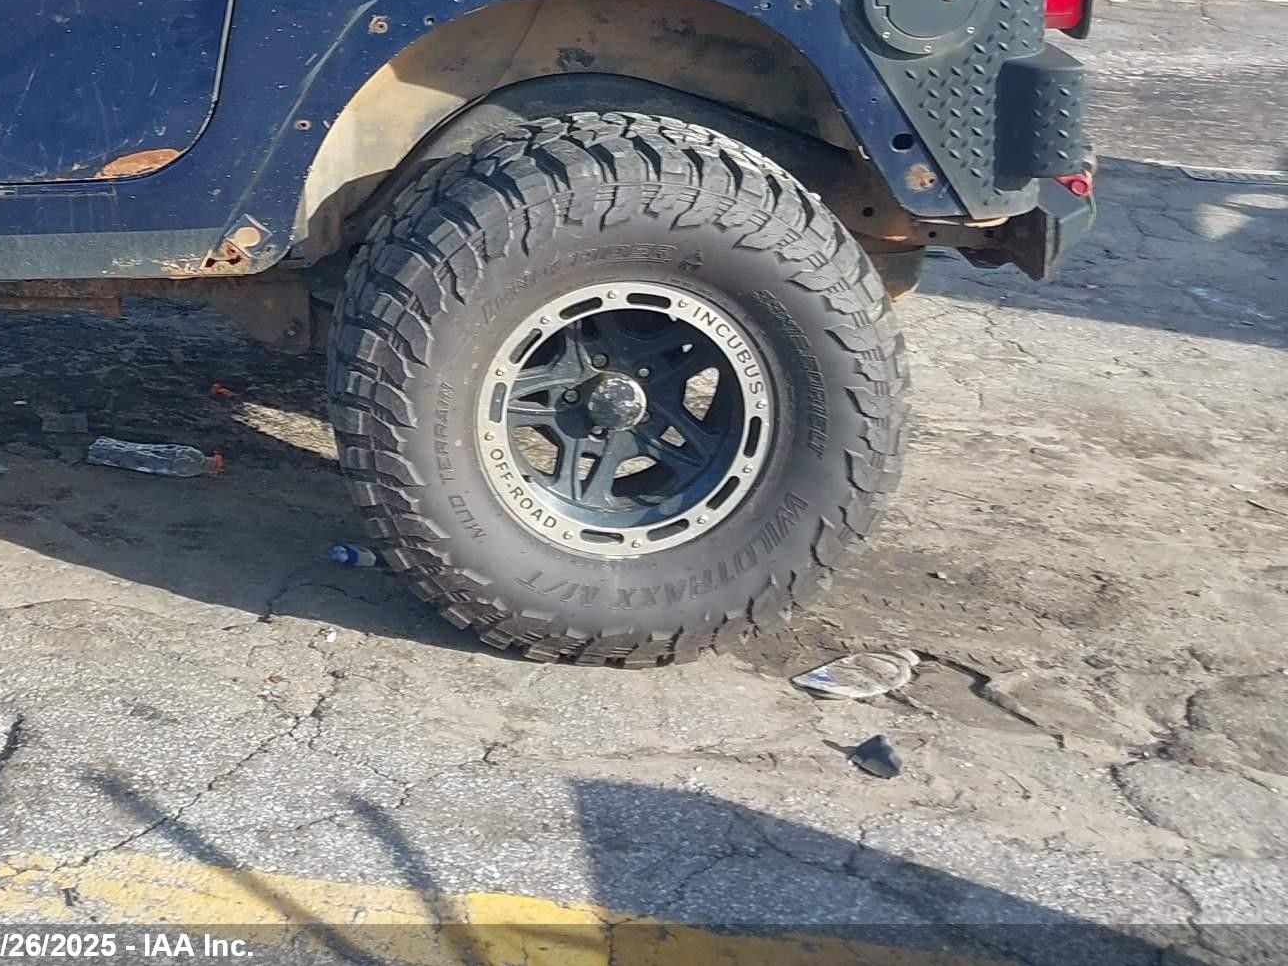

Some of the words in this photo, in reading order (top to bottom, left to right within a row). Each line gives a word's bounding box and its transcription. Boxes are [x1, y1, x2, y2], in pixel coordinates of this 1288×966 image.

[692, 306, 764, 395] INCUBUS
[433, 381, 456, 485] TERRAIN
[489, 448, 558, 529] OFF-ROAD
